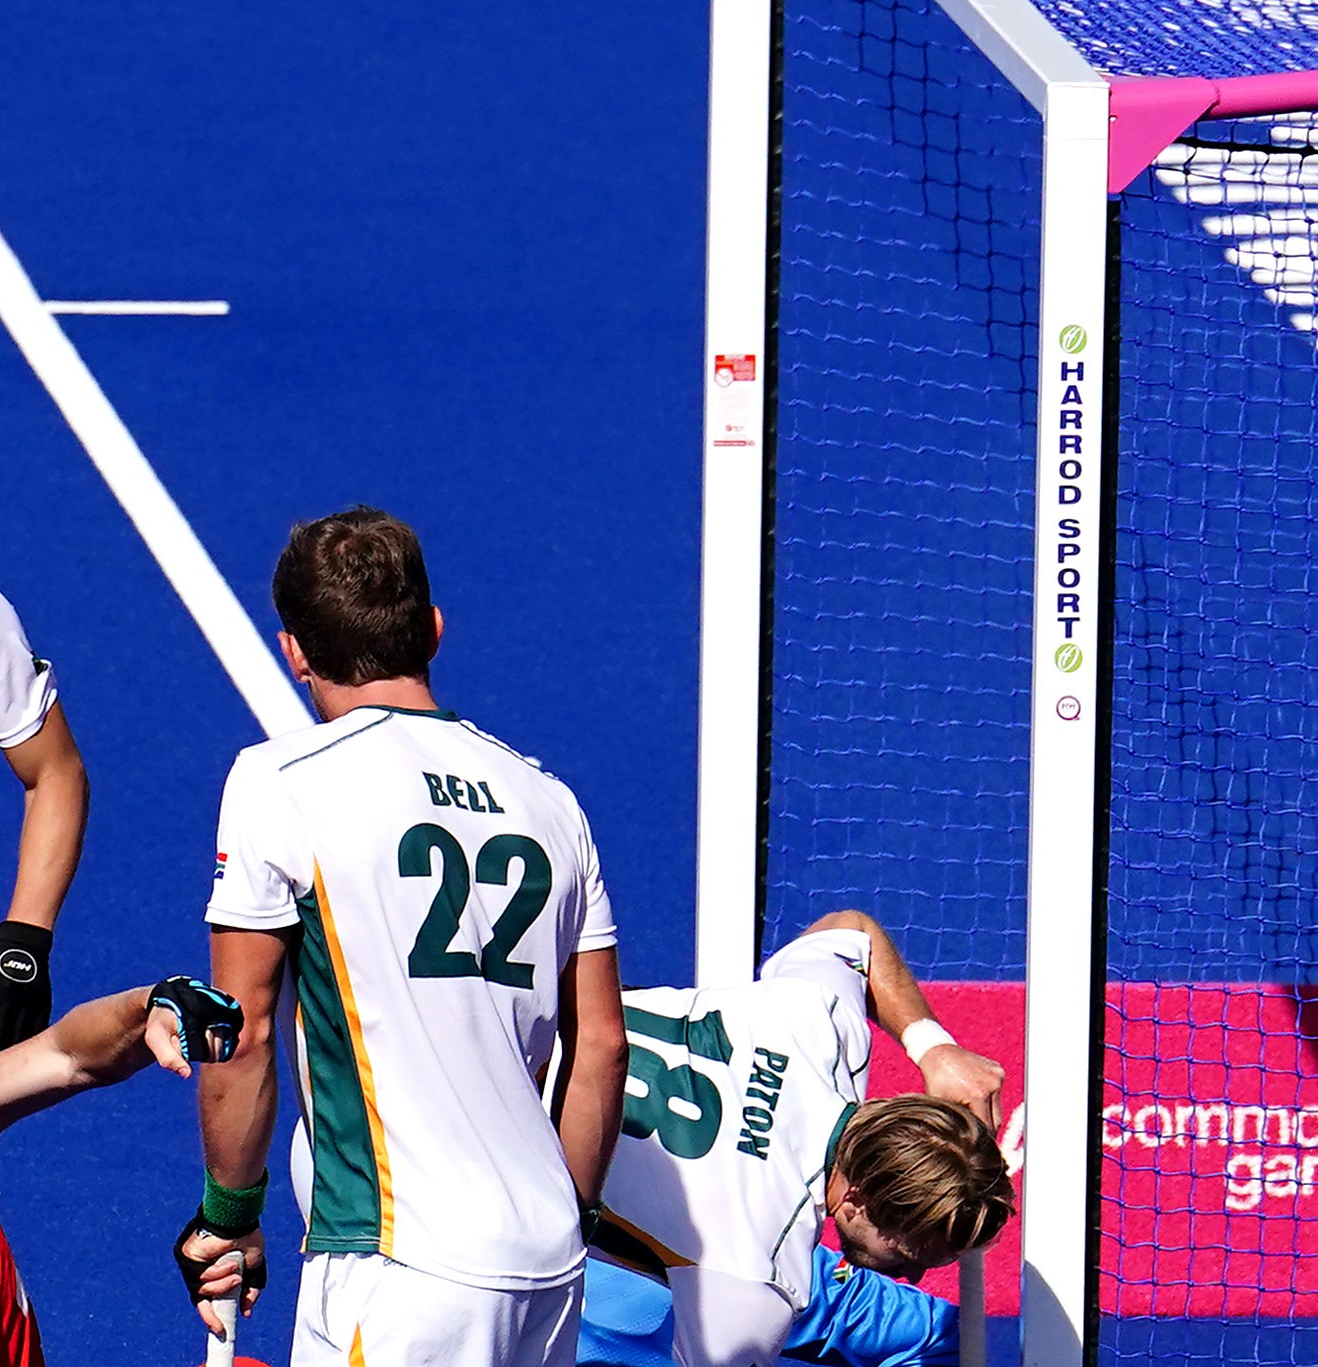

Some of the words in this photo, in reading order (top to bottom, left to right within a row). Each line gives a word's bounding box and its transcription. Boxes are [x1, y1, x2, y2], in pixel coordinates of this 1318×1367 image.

[1058, 361, 1084, 505] HARROD
[1056, 518, 1081, 639] SPORT
[422, 771, 505, 814] BELL
[398, 822, 553, 990] 22
[623, 1009, 734, 1160] 18
[736, 1046, 790, 1162] PATON
